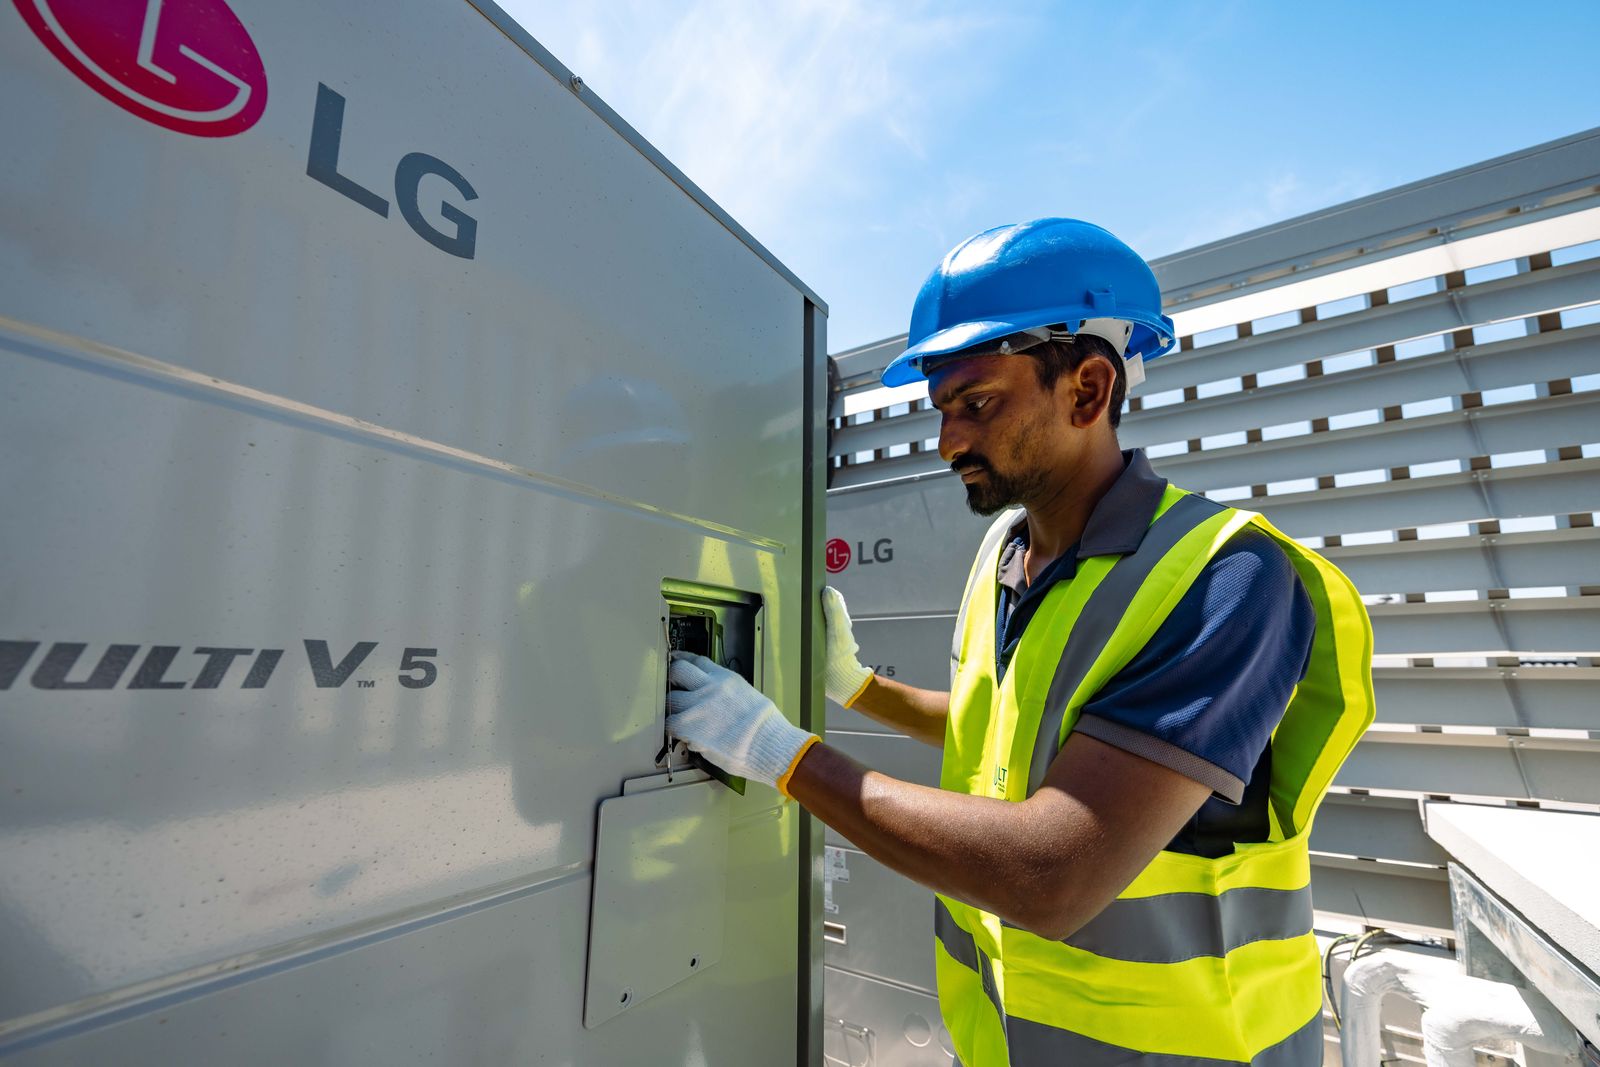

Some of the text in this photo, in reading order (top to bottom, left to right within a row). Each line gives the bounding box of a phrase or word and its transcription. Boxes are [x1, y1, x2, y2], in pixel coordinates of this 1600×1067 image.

[306, 82, 479, 260] LG
[857, 538, 893, 565] LG
[398, 647, 438, 689] 5
[886, 665, 896, 677] 5
